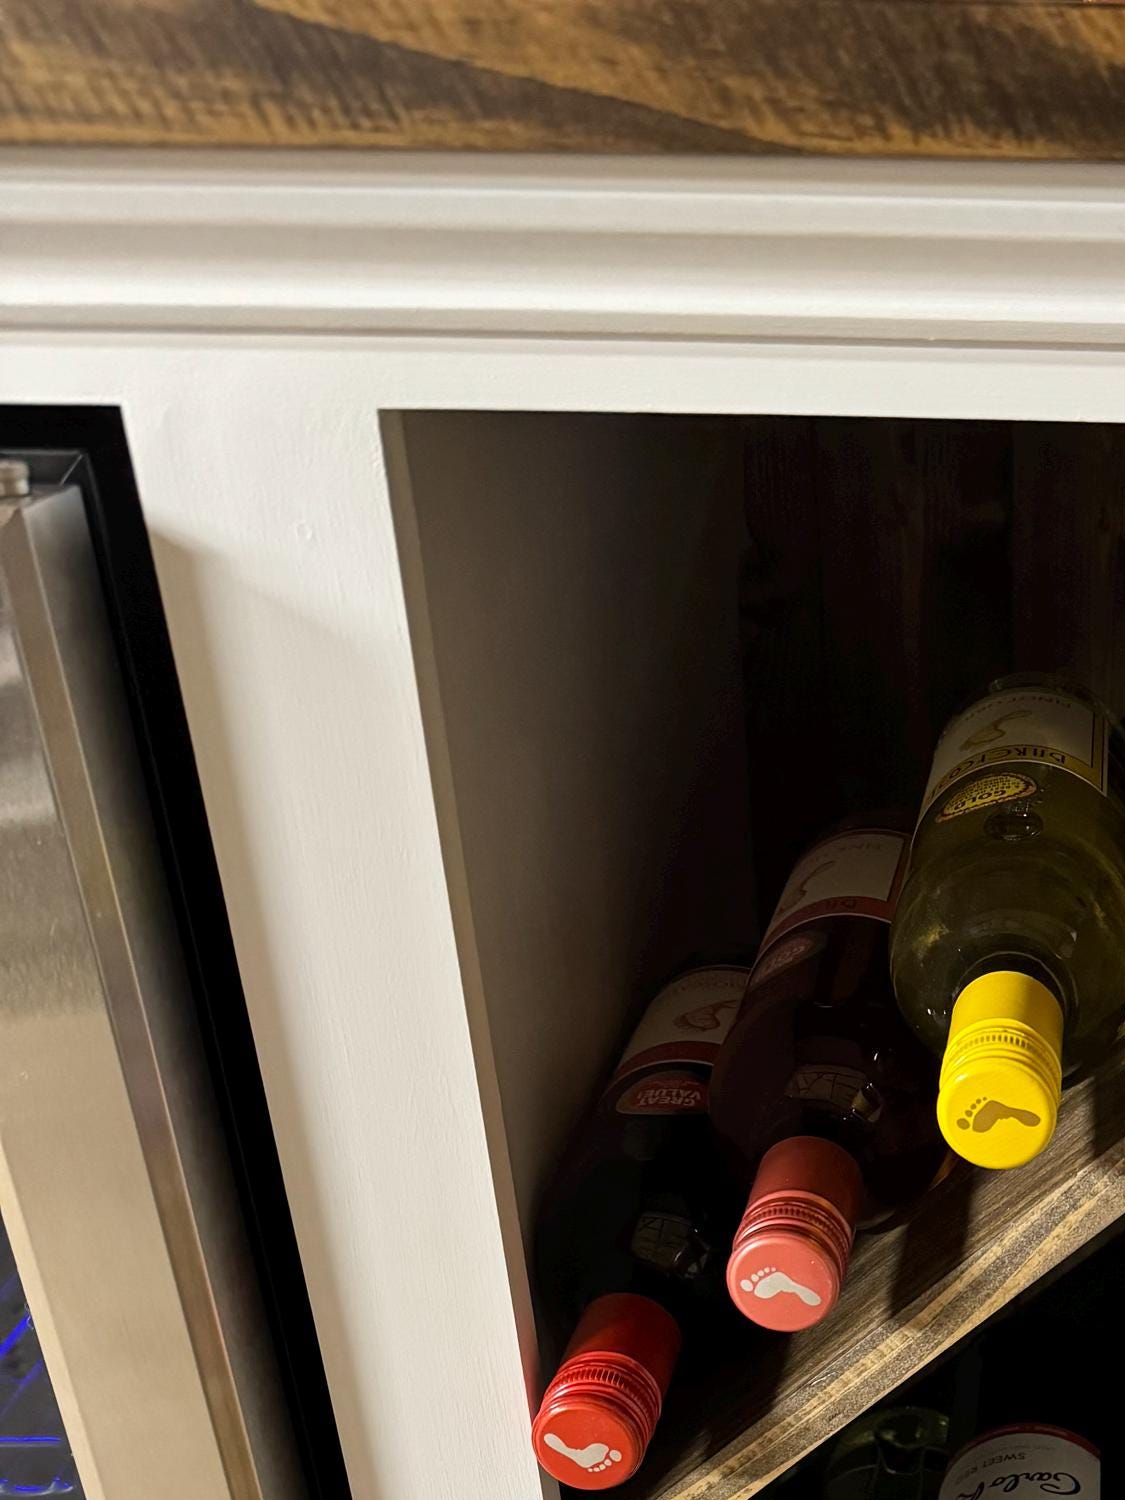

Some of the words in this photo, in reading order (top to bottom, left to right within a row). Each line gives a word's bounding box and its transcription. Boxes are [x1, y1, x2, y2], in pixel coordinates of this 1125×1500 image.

[952, 789, 1007, 811] GOLD
[638, 1094, 696, 1108] GREAT
[982, 1451, 1027, 1469] SWEET
[989, 1471, 1081, 1496] Carlo
